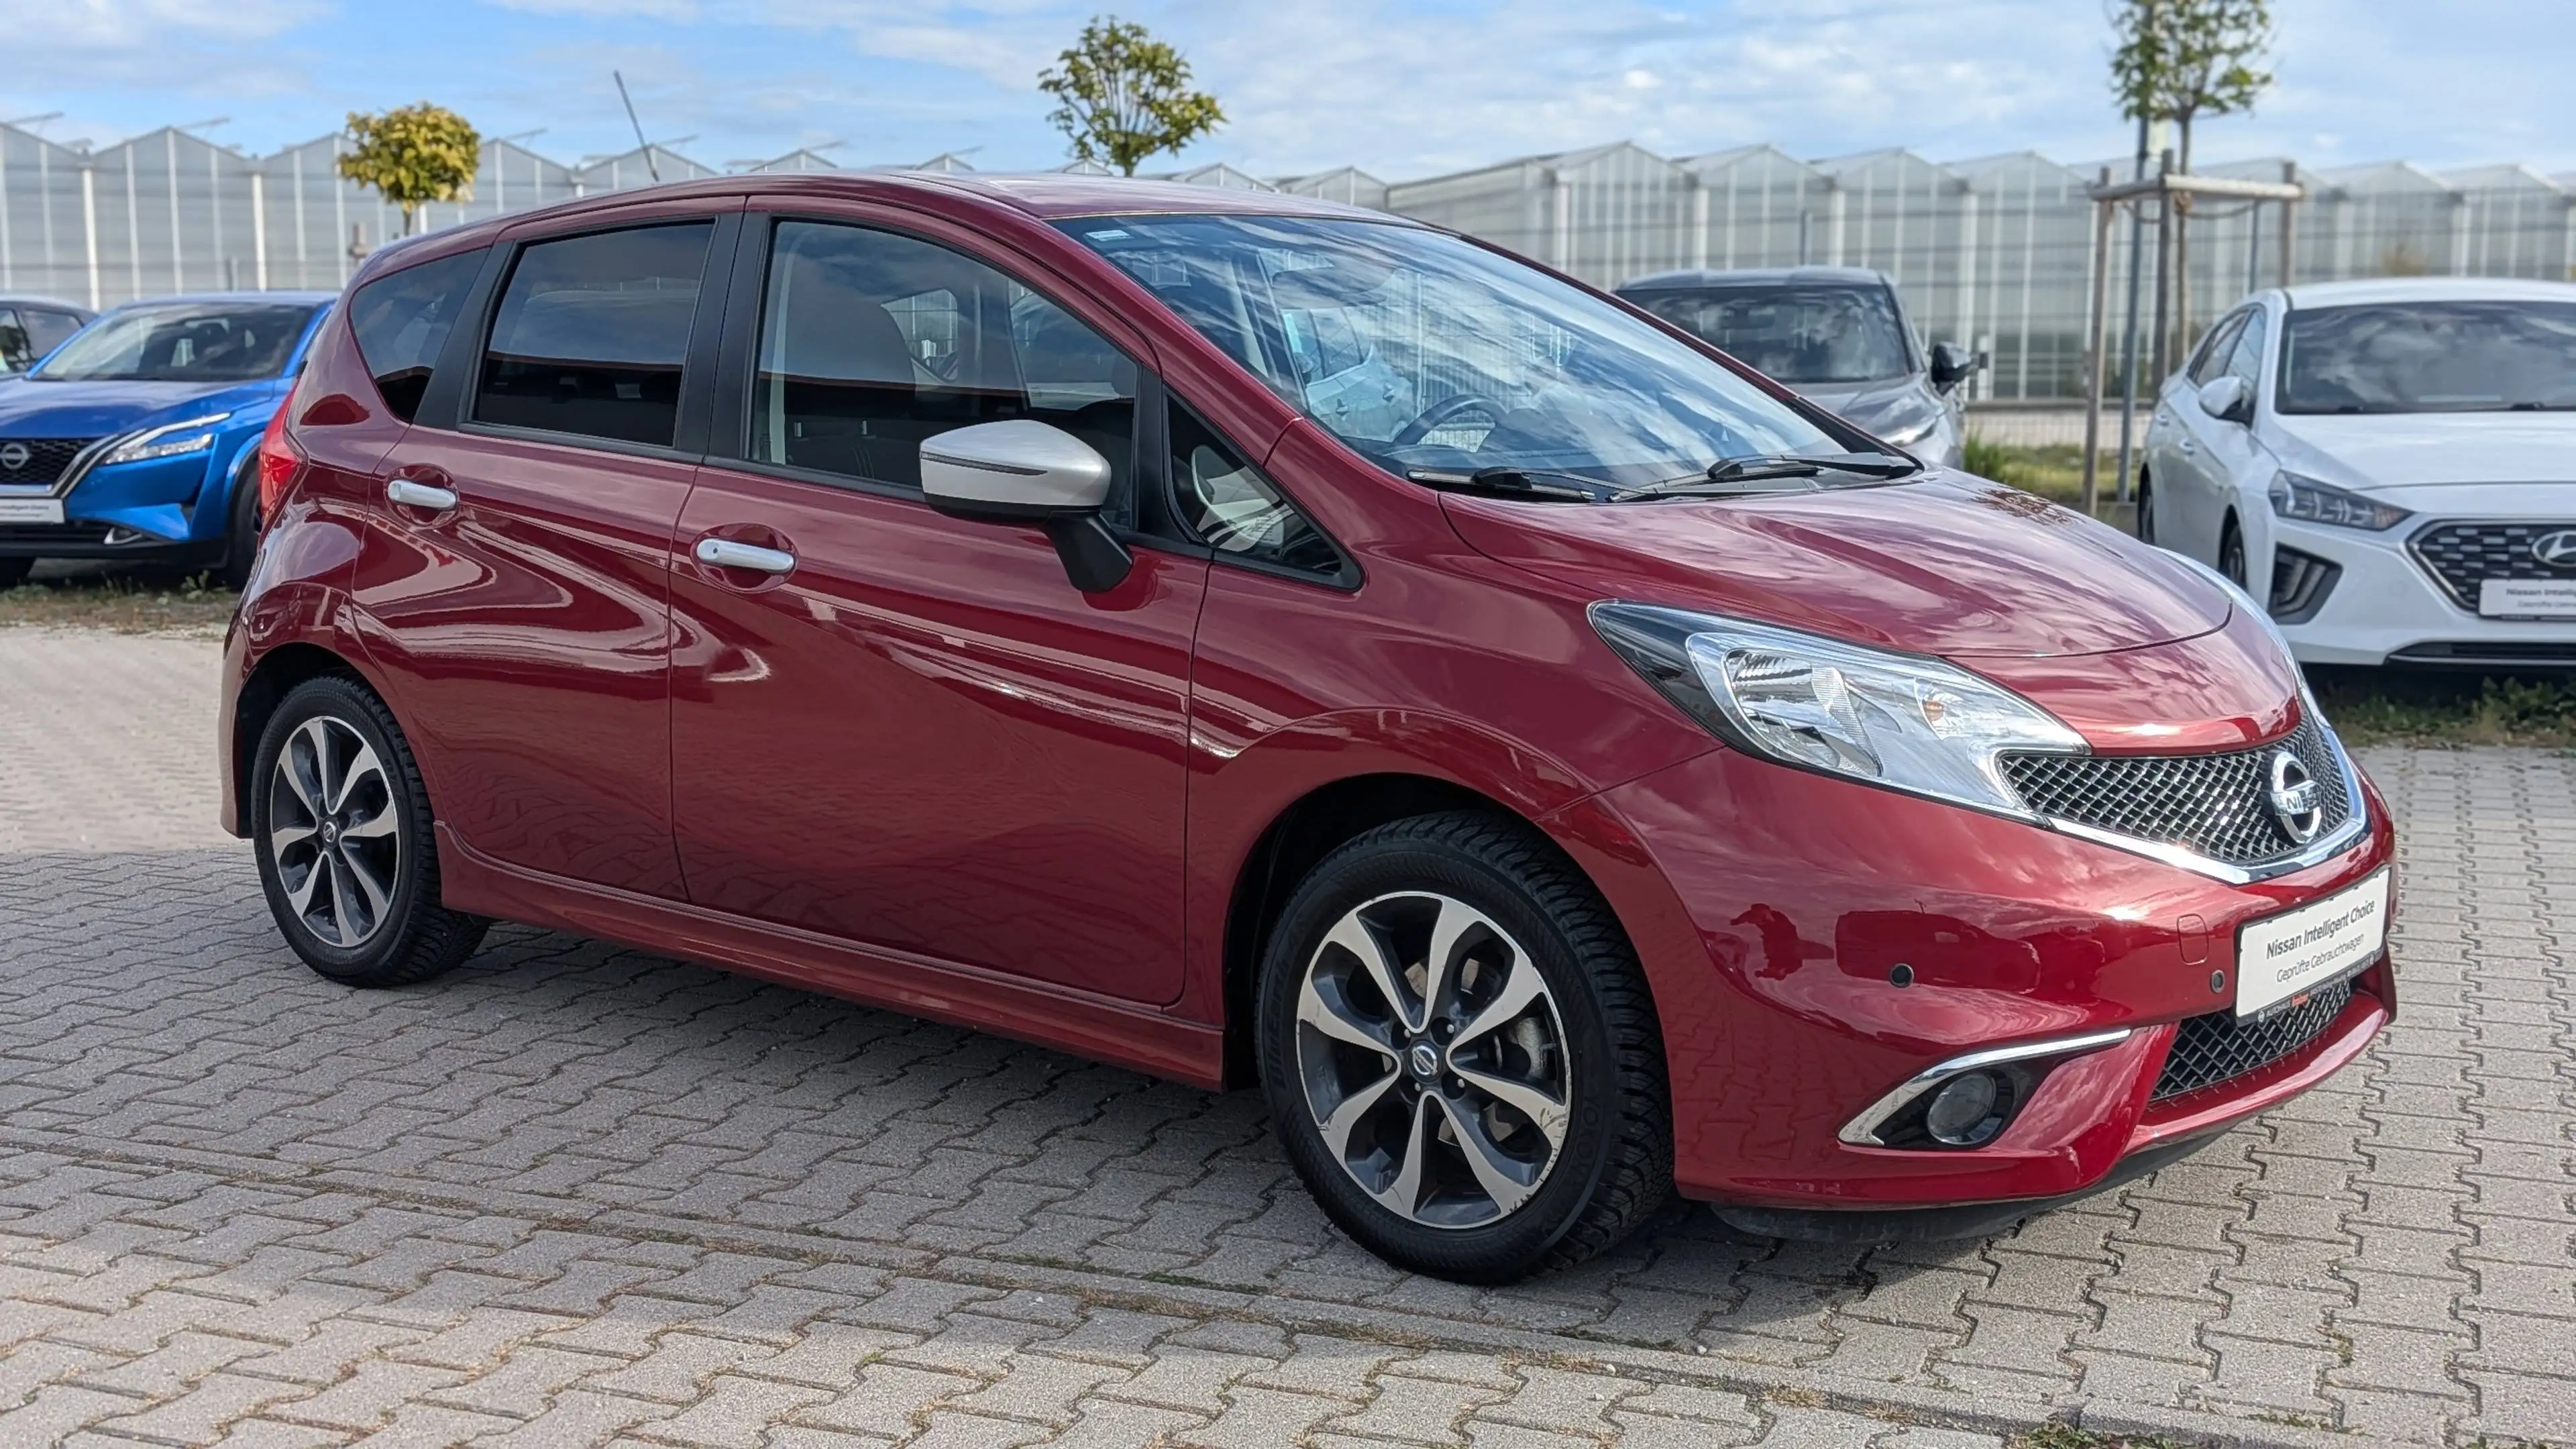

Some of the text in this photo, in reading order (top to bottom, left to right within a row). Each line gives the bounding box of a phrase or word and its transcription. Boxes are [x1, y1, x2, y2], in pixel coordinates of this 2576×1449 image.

[2266, 900, 2375, 959] Nissan Intelligent Choice
[2277, 959, 2310, 983] Geprüfte
[2311, 933, 2364, 968] Gebrauchtwagen
